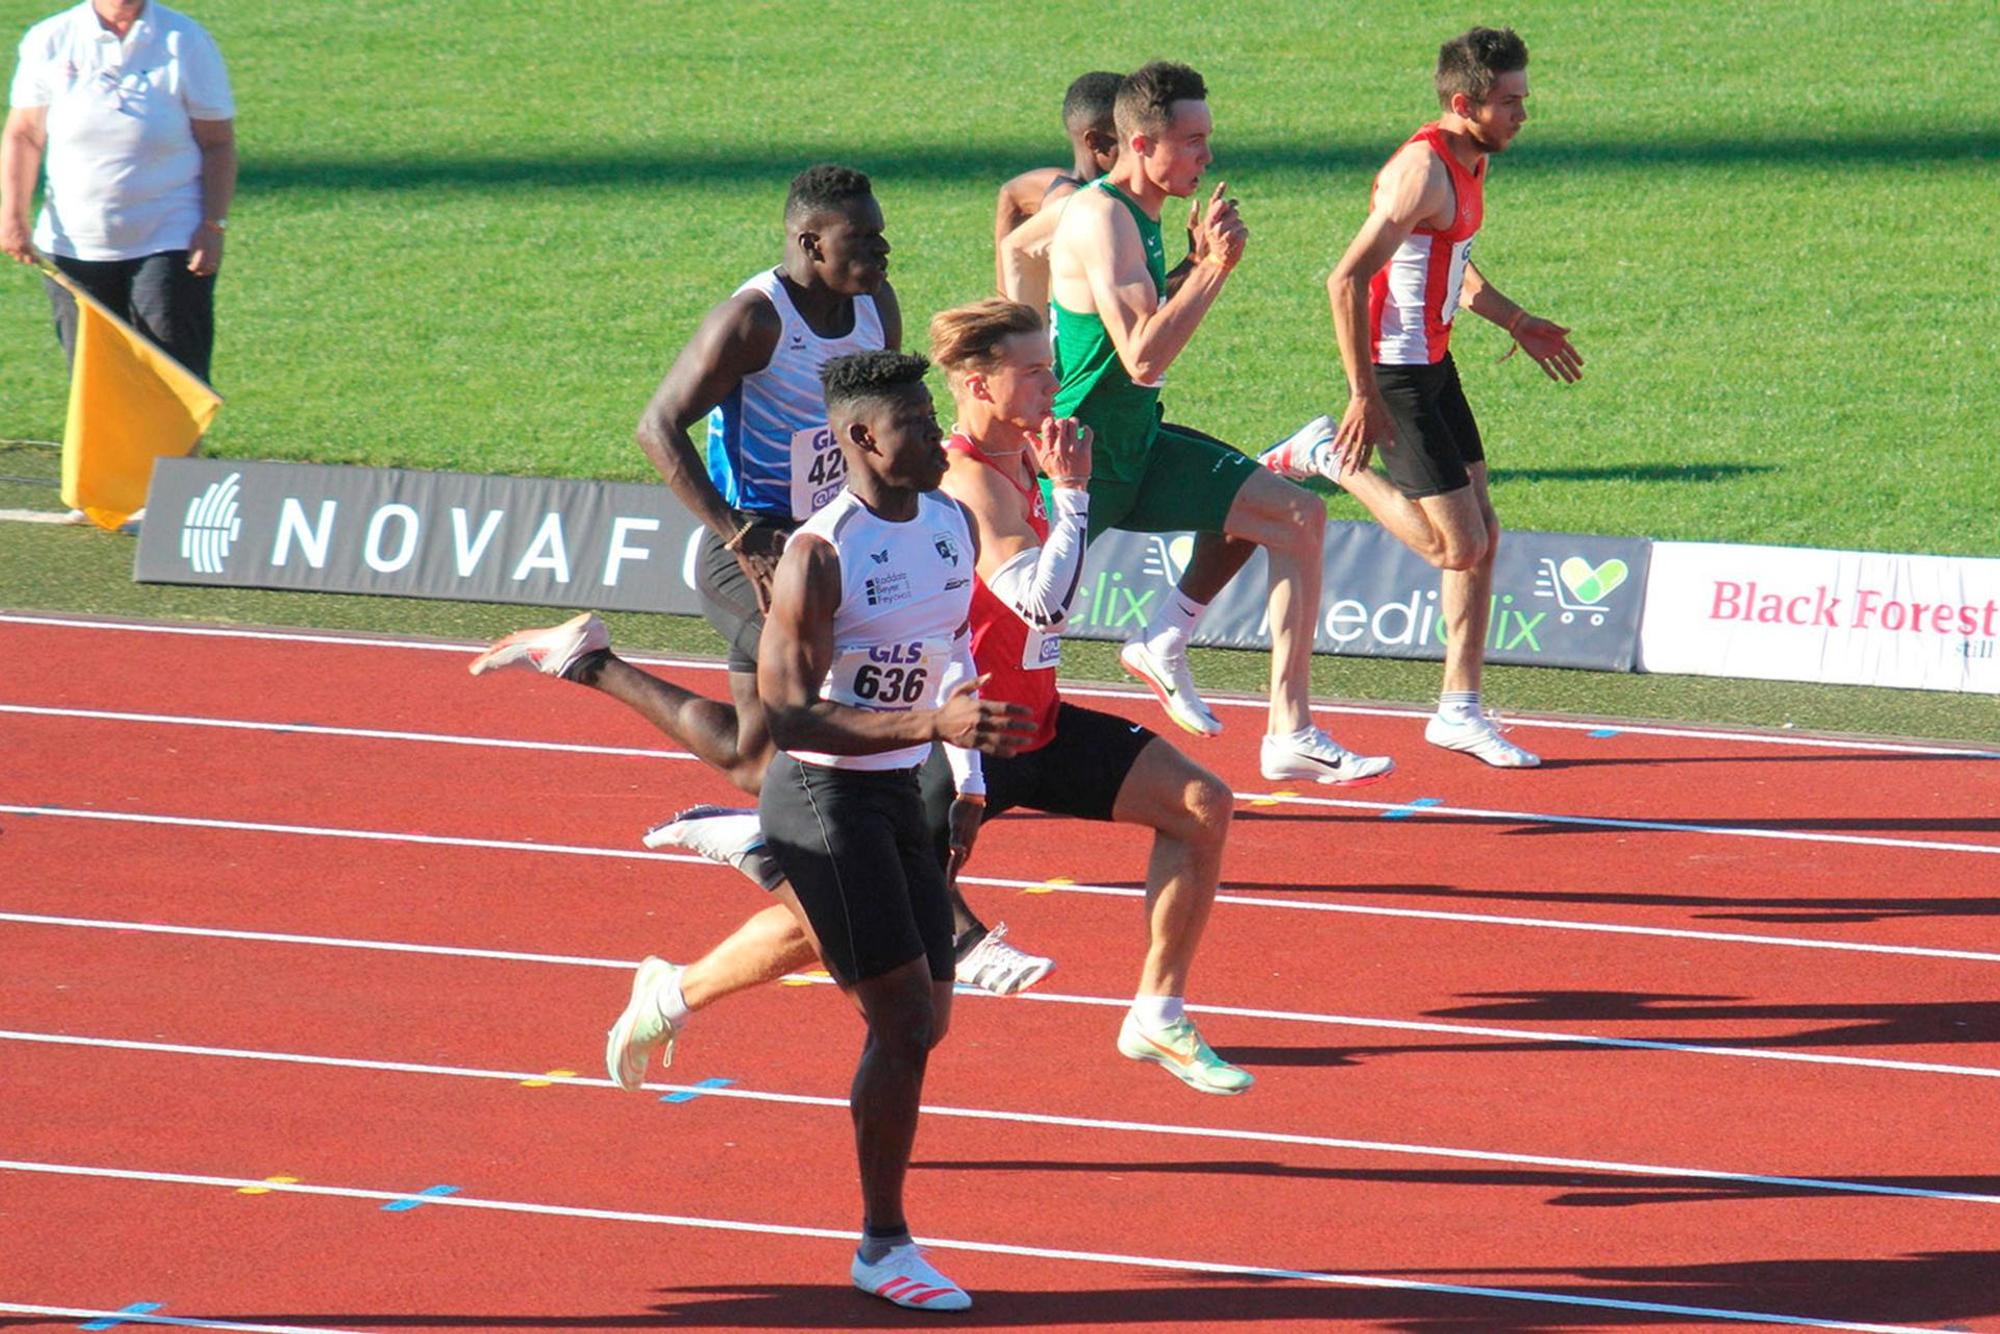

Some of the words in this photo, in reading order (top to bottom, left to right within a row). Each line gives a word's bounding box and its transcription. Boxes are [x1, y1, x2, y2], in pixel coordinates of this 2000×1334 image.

[812, 429, 838, 452] GL
[1257, 590, 1547, 652] edilix
[1709, 580, 1841, 628] Black
[1851, 589, 1999, 637] Forest
[853, 664, 928, 703] 636
